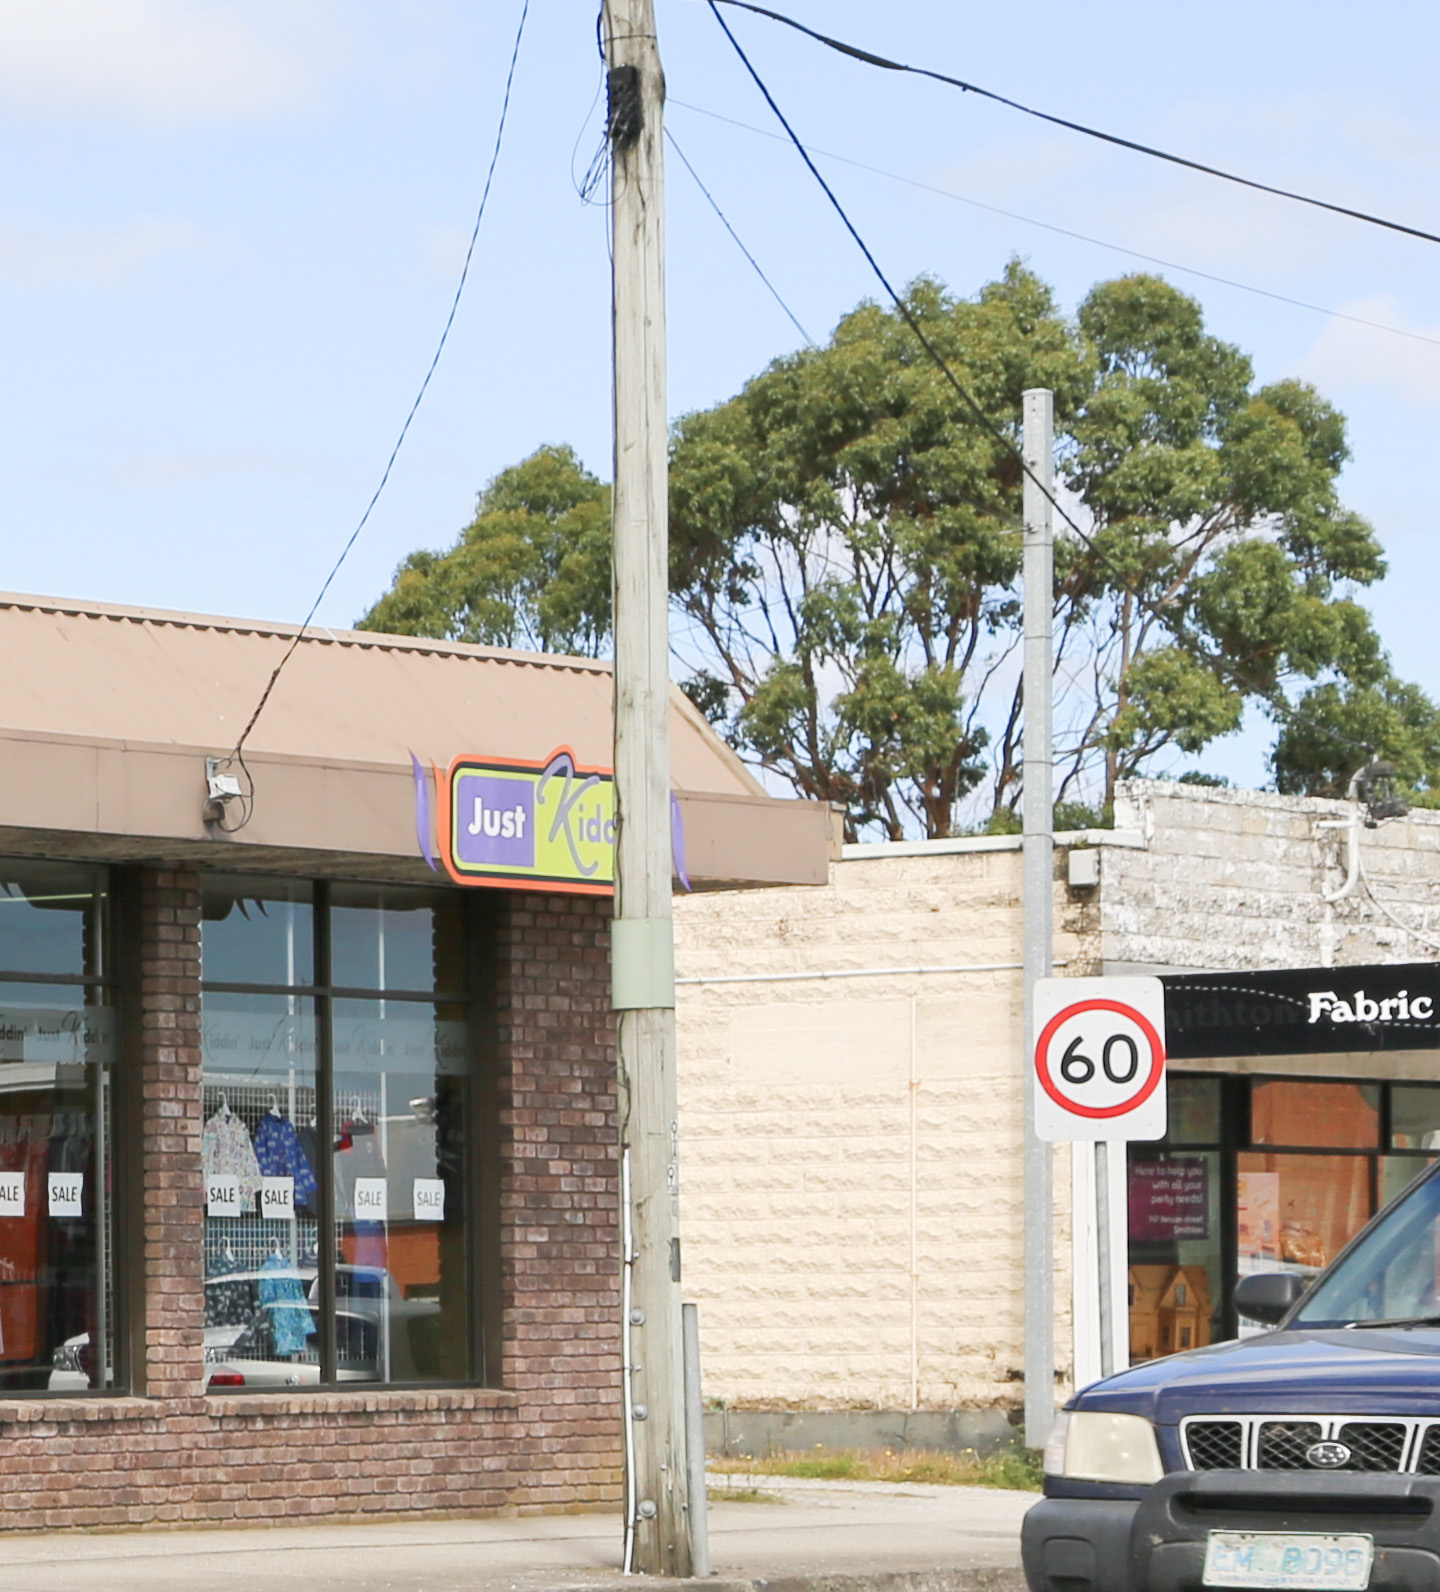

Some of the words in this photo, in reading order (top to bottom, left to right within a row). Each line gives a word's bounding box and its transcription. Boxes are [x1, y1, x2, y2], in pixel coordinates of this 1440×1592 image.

[466, 796, 527, 838] Just
[1307, 990, 1434, 1024] Fabric
[1060, 1033, 1138, 1085] 60
[1134, 1165, 1155, 1176] Here
[1156, 1165, 1166, 1176] to
[51, 1186, 77, 1202] SALE
[210, 1187, 236, 1203] SALE
[264, 1189, 290, 1206] SALE
[357, 1190, 382, 1207] SALE
[416, 1190, 441, 1207] SALE
